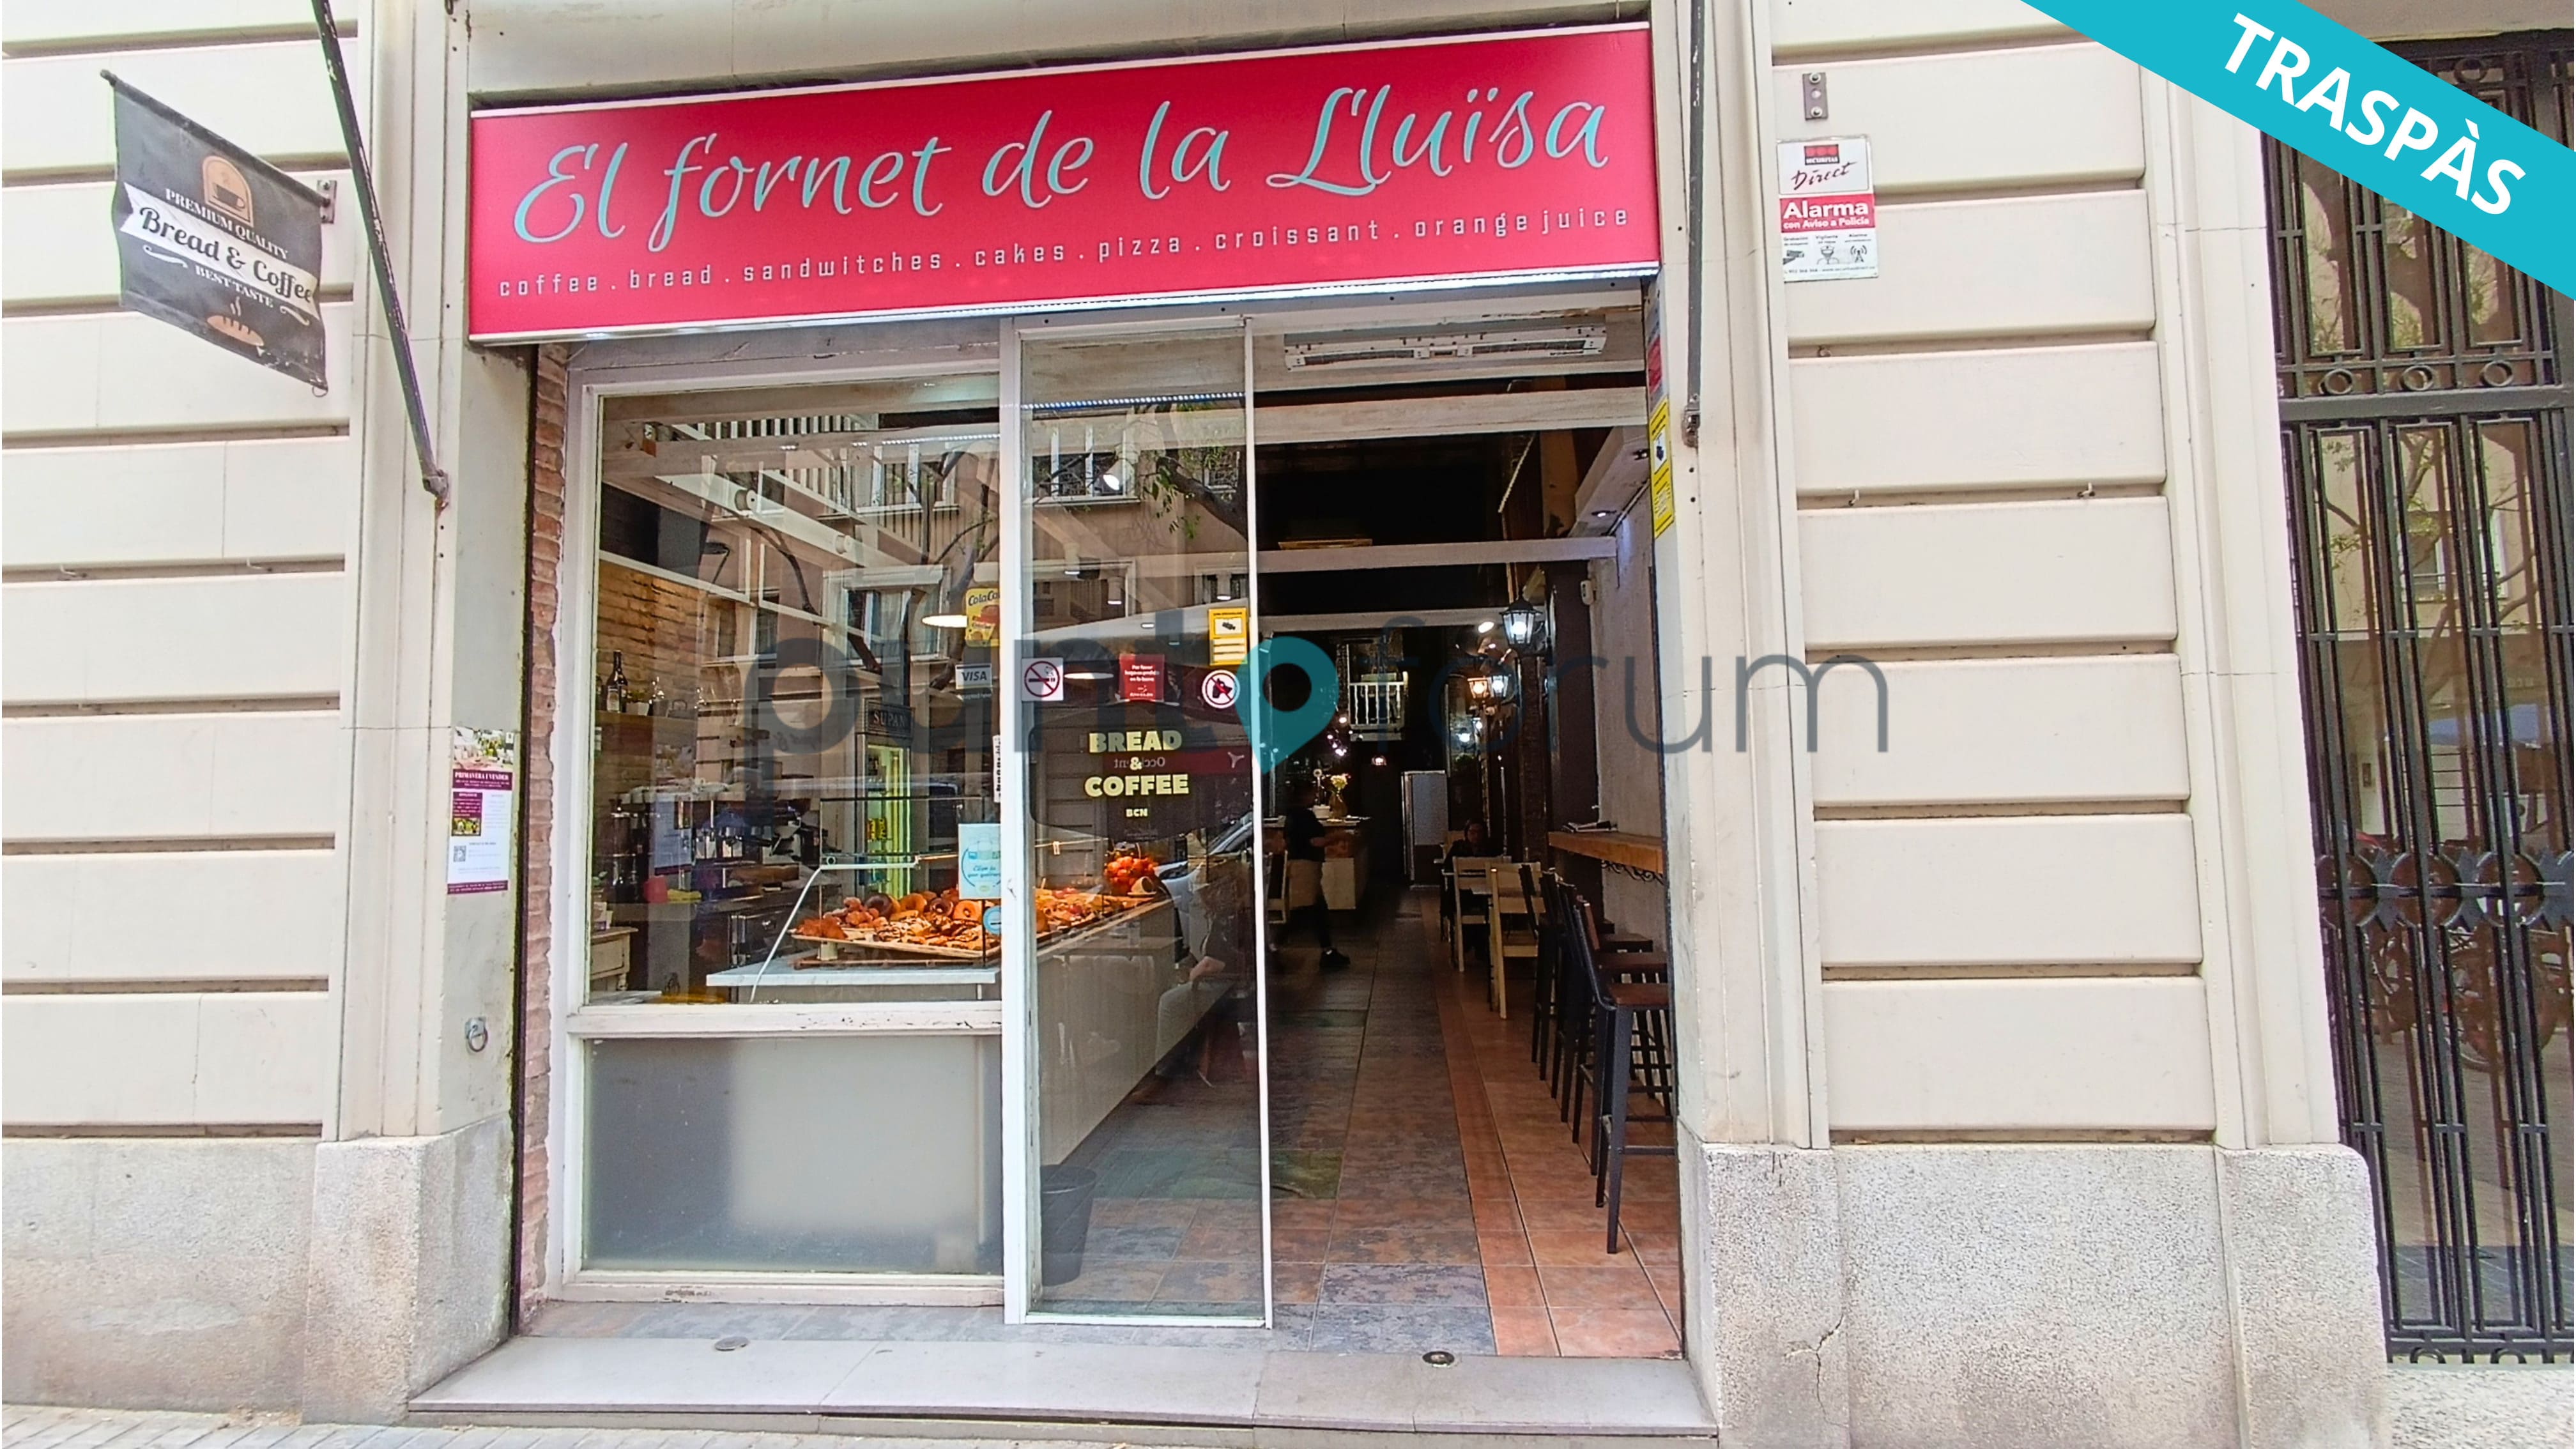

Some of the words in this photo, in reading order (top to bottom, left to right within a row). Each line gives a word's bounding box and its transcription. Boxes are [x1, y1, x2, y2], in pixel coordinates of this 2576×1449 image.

[513, 142, 628, 244] El
[647, 132, 952, 252] fornet
[981, 109, 1094, 208] de
[1139, 100, 1231, 199] la
[1266, 83, 1608, 196] Lluïsa
[1791, 162, 1858, 190] Direct
[1783, 200, 1869, 218] Alarma
[165, 188, 233, 232] PREMIUM
[234, 222, 289, 259] QUALITY
[1802, 218, 1828, 227] Aviso
[139, 206, 220, 261] Bread
[226, 247, 246, 270] &
[253, 259, 312, 303] Coffee
[499, 273, 599, 298] coffee
[629, 264, 712, 289] bread
[743, 251, 942, 282] sandwitches
[974, 242, 1065, 266] cakes
[1098, 234, 1180, 263] pizza
[1215, 218, 1379, 250] croissant
[1414, 211, 1529, 238] orange
[1542, 206, 1629, 234] juice
[195, 264, 230, 289] BEST
[230, 277, 274, 308] TASTE
[969, 590, 1000, 606] ColaCa
[962, 671, 987, 681] VISA
[1089, 730, 1182, 753] BREAD
[1130, 756, 1142, 770] &
[1084, 774, 1189, 797] COFFEE
[1126, 808, 1148, 817] BCN
